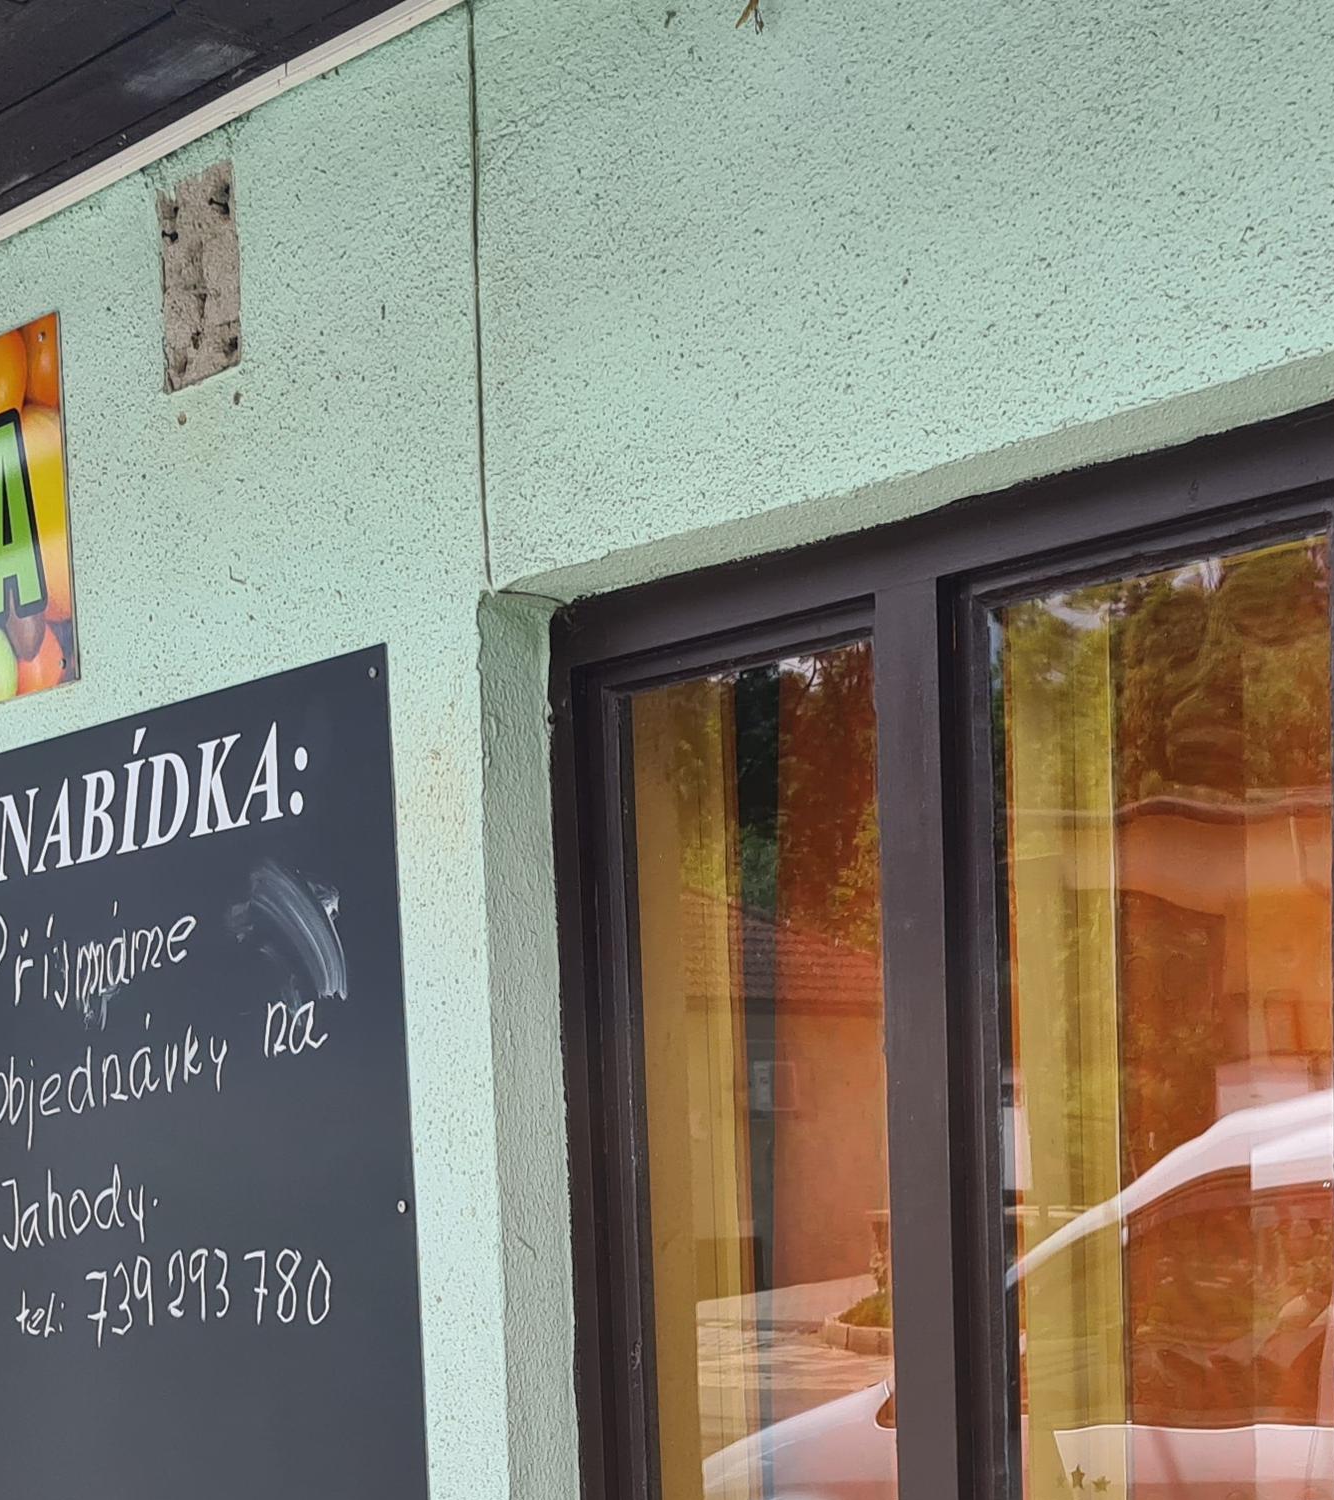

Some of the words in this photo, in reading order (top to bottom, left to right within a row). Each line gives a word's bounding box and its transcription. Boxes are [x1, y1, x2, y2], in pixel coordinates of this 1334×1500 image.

[264, 1000, 329, 1058] na
[85, 1255, 155, 1348] 739
[167, 1248, 230, 1322] 293
[244, 1248, 332, 1326] 780
